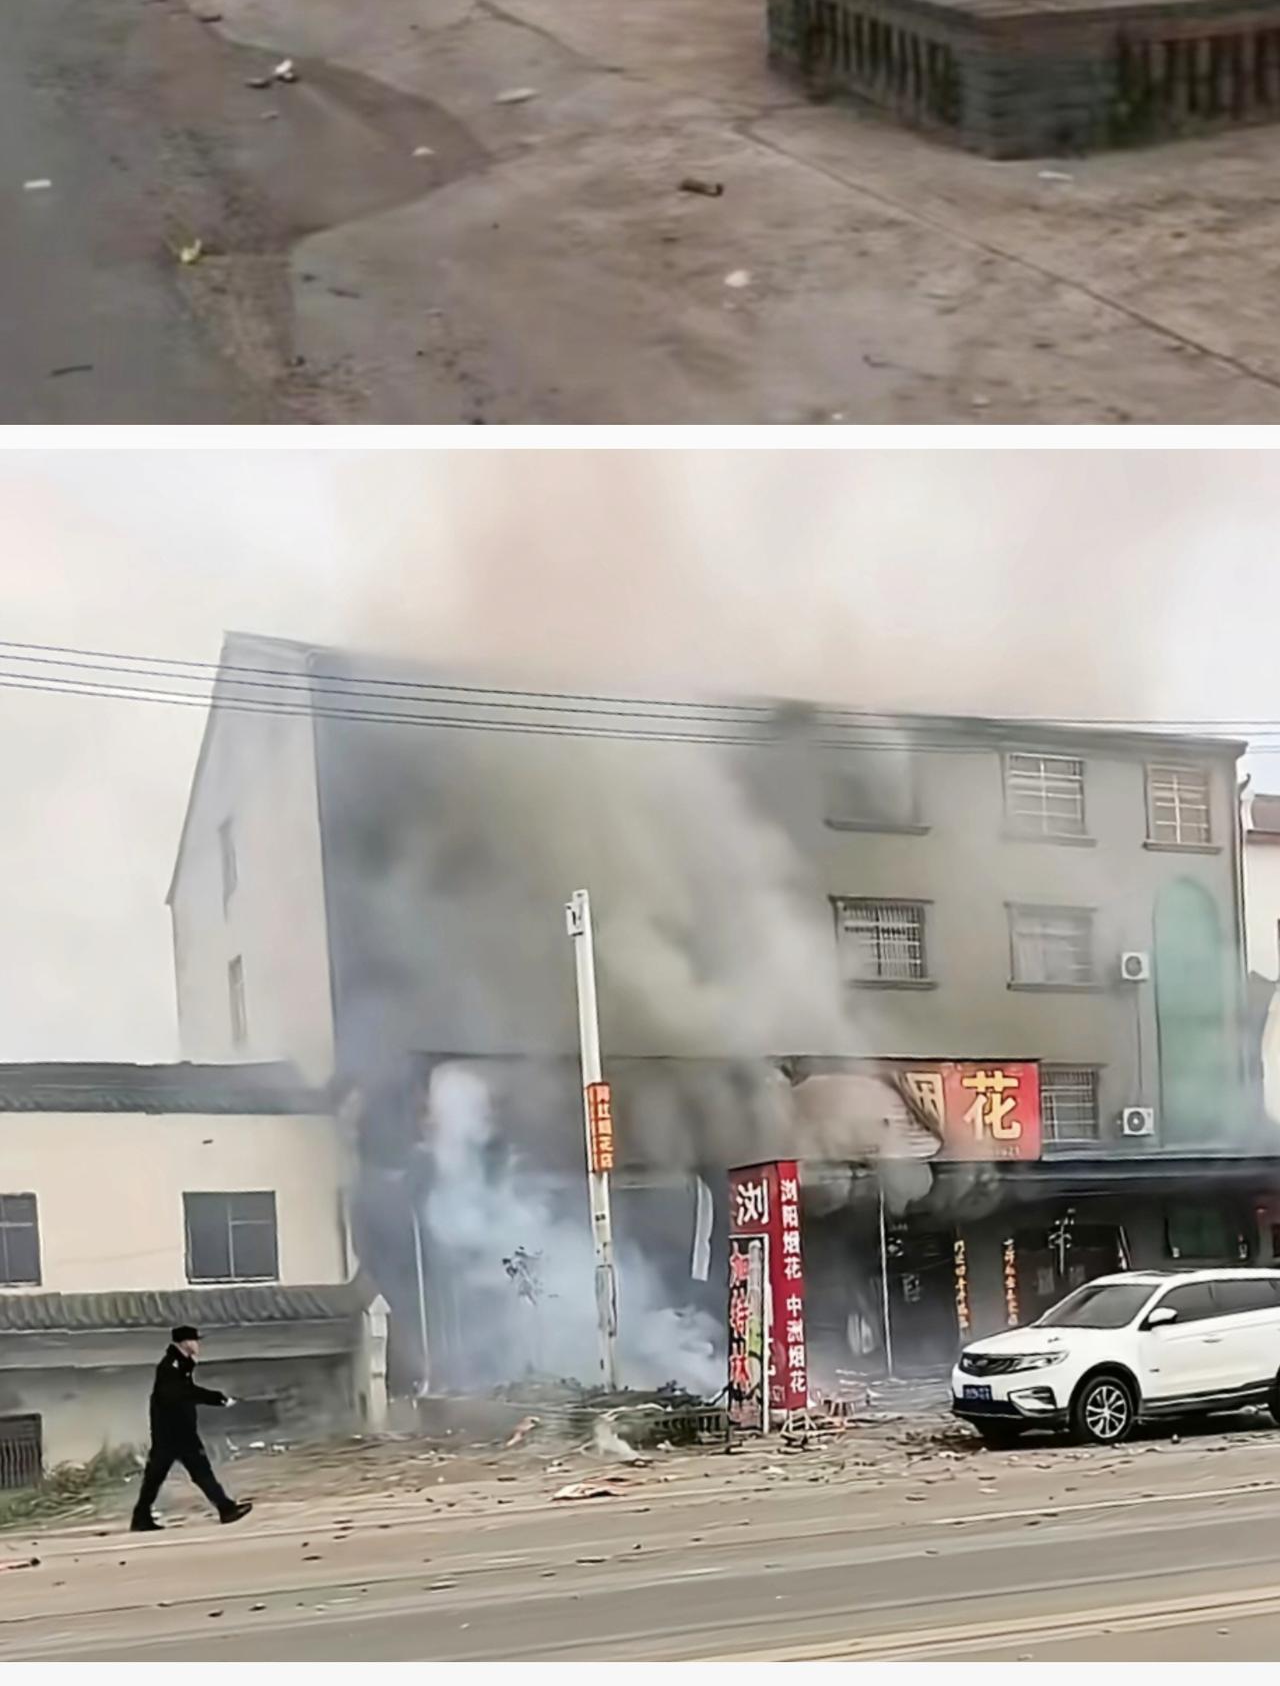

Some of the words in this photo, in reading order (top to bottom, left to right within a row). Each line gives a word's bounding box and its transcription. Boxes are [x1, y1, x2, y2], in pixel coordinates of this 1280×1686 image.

[780, 1178, 802, 1281] 浏阳烟花
[786, 1293, 806, 1393] 中洲烟花
